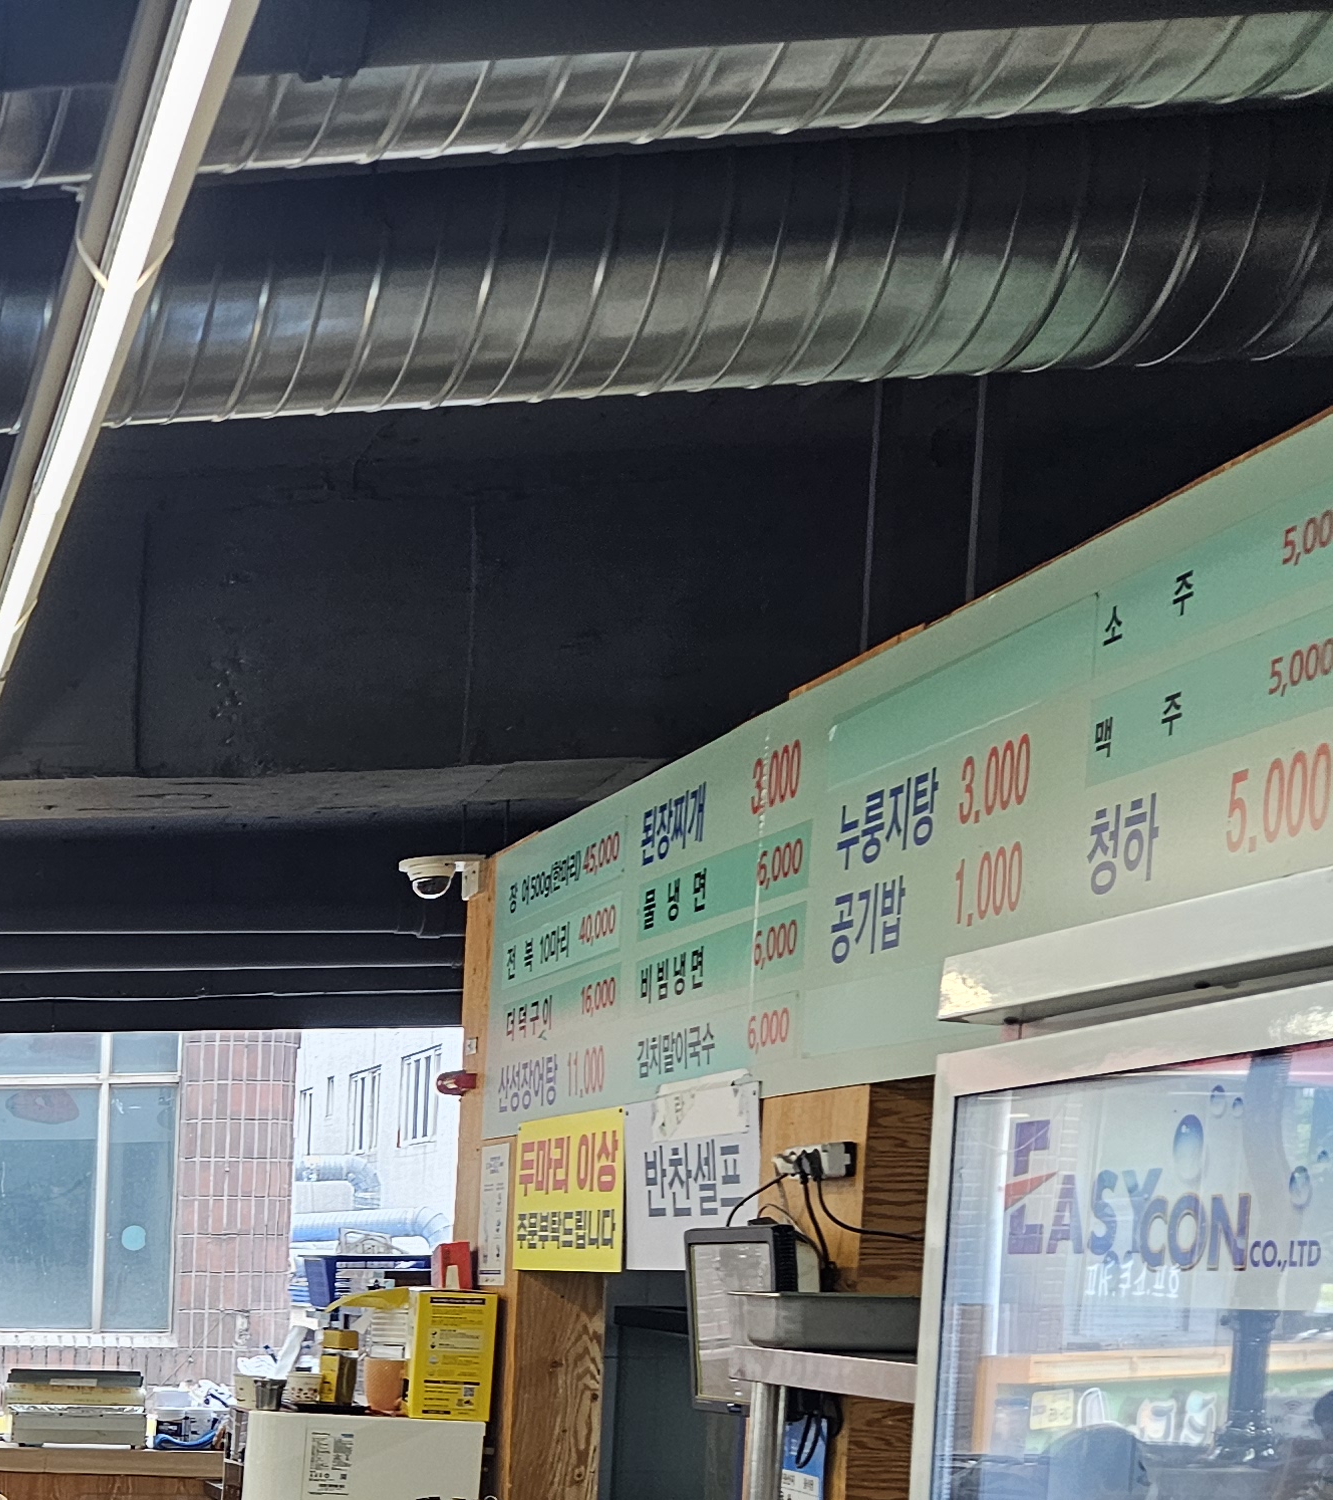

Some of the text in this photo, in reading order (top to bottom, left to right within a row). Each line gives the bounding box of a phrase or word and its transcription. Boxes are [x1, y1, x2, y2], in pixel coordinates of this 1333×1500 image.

[641, 781, 707, 866] 된장찌개
[836, 766, 939, 870] 누룽지탕
[1086, 791, 1160, 896] 청하
[583, 831, 620, 875] 45,000
[757, 838, 803, 890] 6,000
[539, 921, 570, 964] 10마리
[578, 904, 616, 946] 40,000
[753, 919, 797, 970] 6,000
[830, 874, 906, 964] 공기밥
[581, 976, 616, 1017] 16,000
[637, 1007, 790, 1078] 김치말이국수 6,000
[498, 1053, 558, 1113] 산성장어탕
[518, 1129, 619, 1197] 두마리 이상
[644, 1139, 745, 1218] 반찬셀프
[517, 1208, 616, 1250] 주문부탁드립니다
